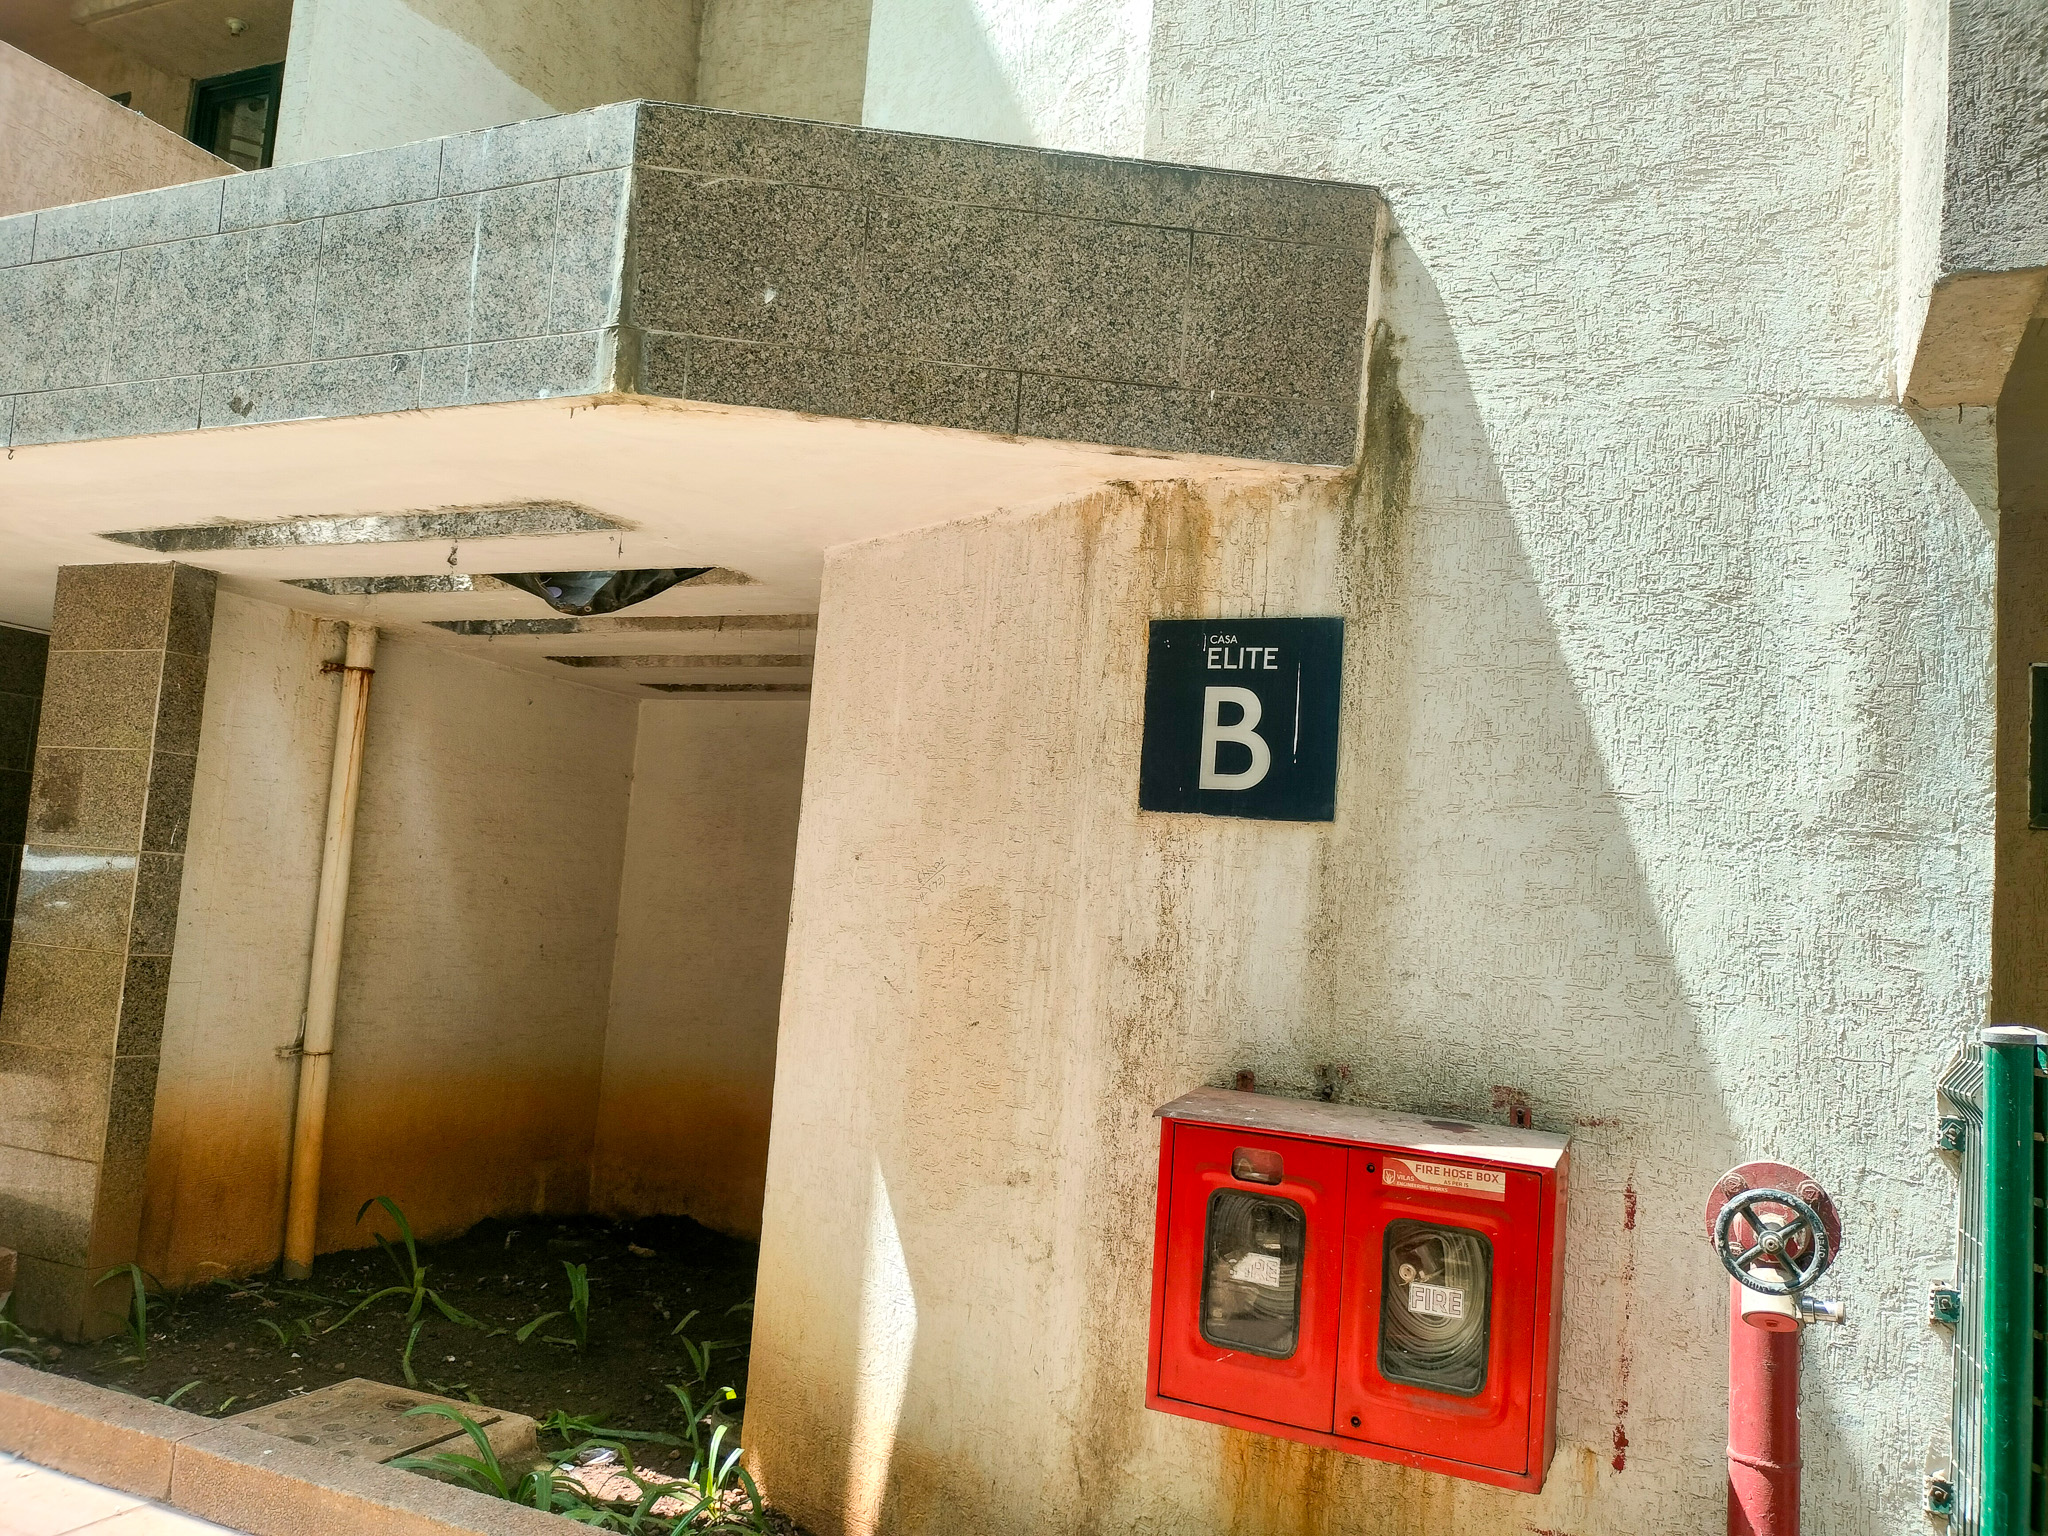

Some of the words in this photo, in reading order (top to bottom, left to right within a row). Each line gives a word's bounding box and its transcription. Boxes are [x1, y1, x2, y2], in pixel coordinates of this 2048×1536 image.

[1209, 634, 1238, 645] CASA
[1207, 647, 1279, 670] ELITE
[1198, 686, 1272, 791] B
[1396, 1174, 1415, 1182] VILAS
[1415, 1164, 1440, 1176] FIRE
[1443, 1168, 1473, 1180] HOSE
[1476, 1171, 1500, 1184] BOX
[1411, 1285, 1462, 1316] FIRE
